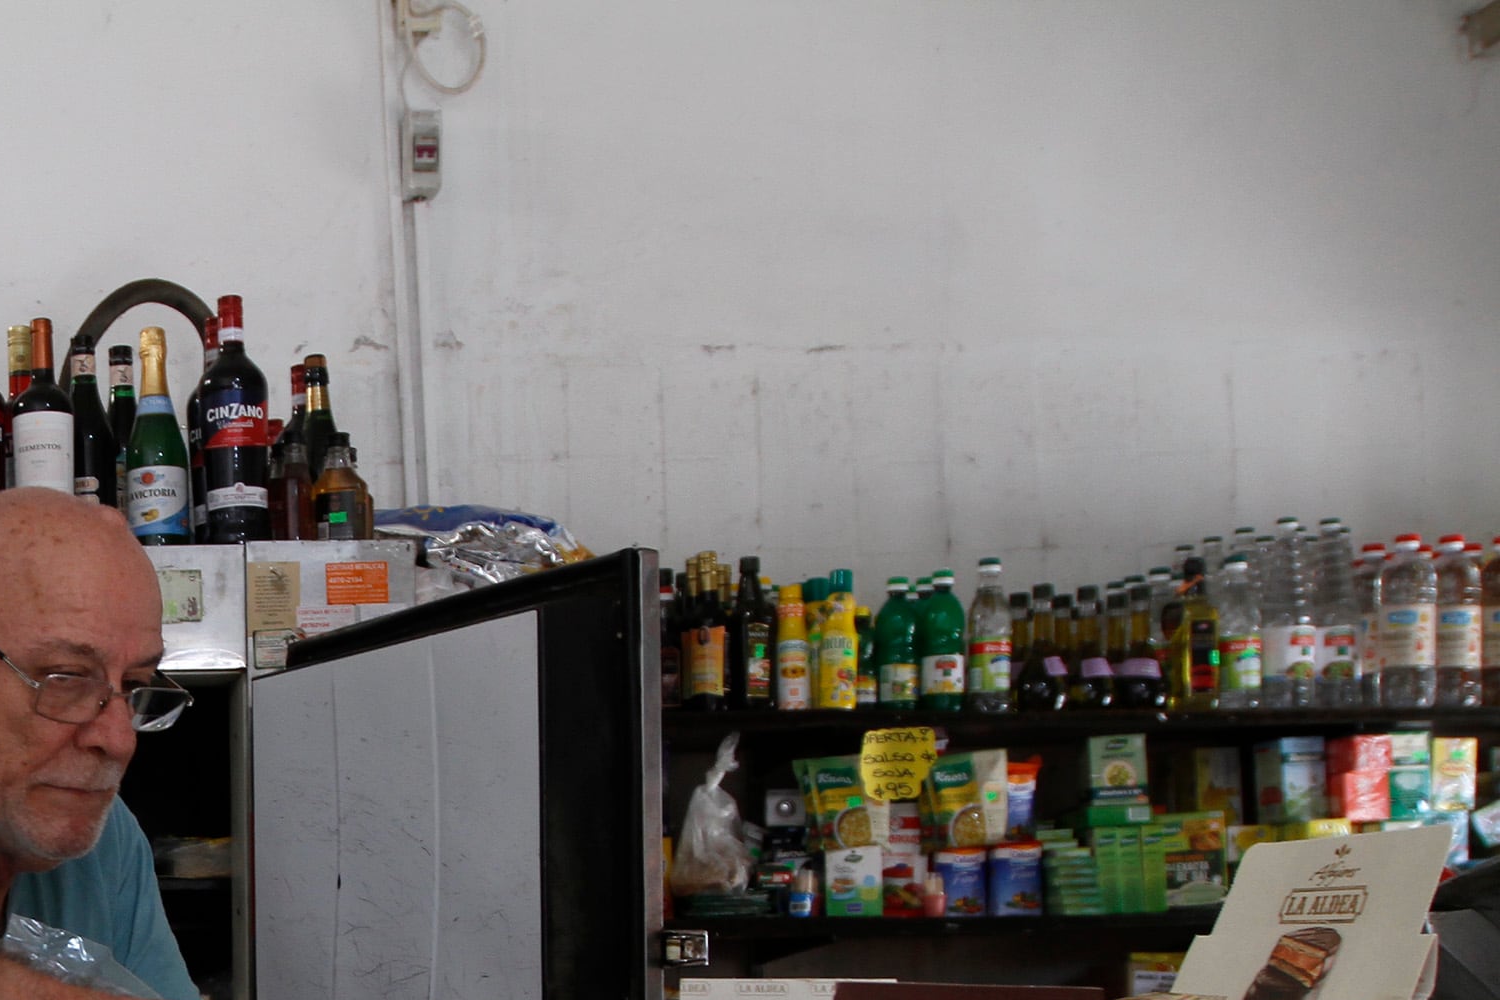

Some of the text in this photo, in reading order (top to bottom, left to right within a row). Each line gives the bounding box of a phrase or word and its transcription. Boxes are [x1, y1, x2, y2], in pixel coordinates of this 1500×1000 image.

[206, 402, 263, 422] CINZANO
[1284, 894, 1362, 916] LA ALDEA
